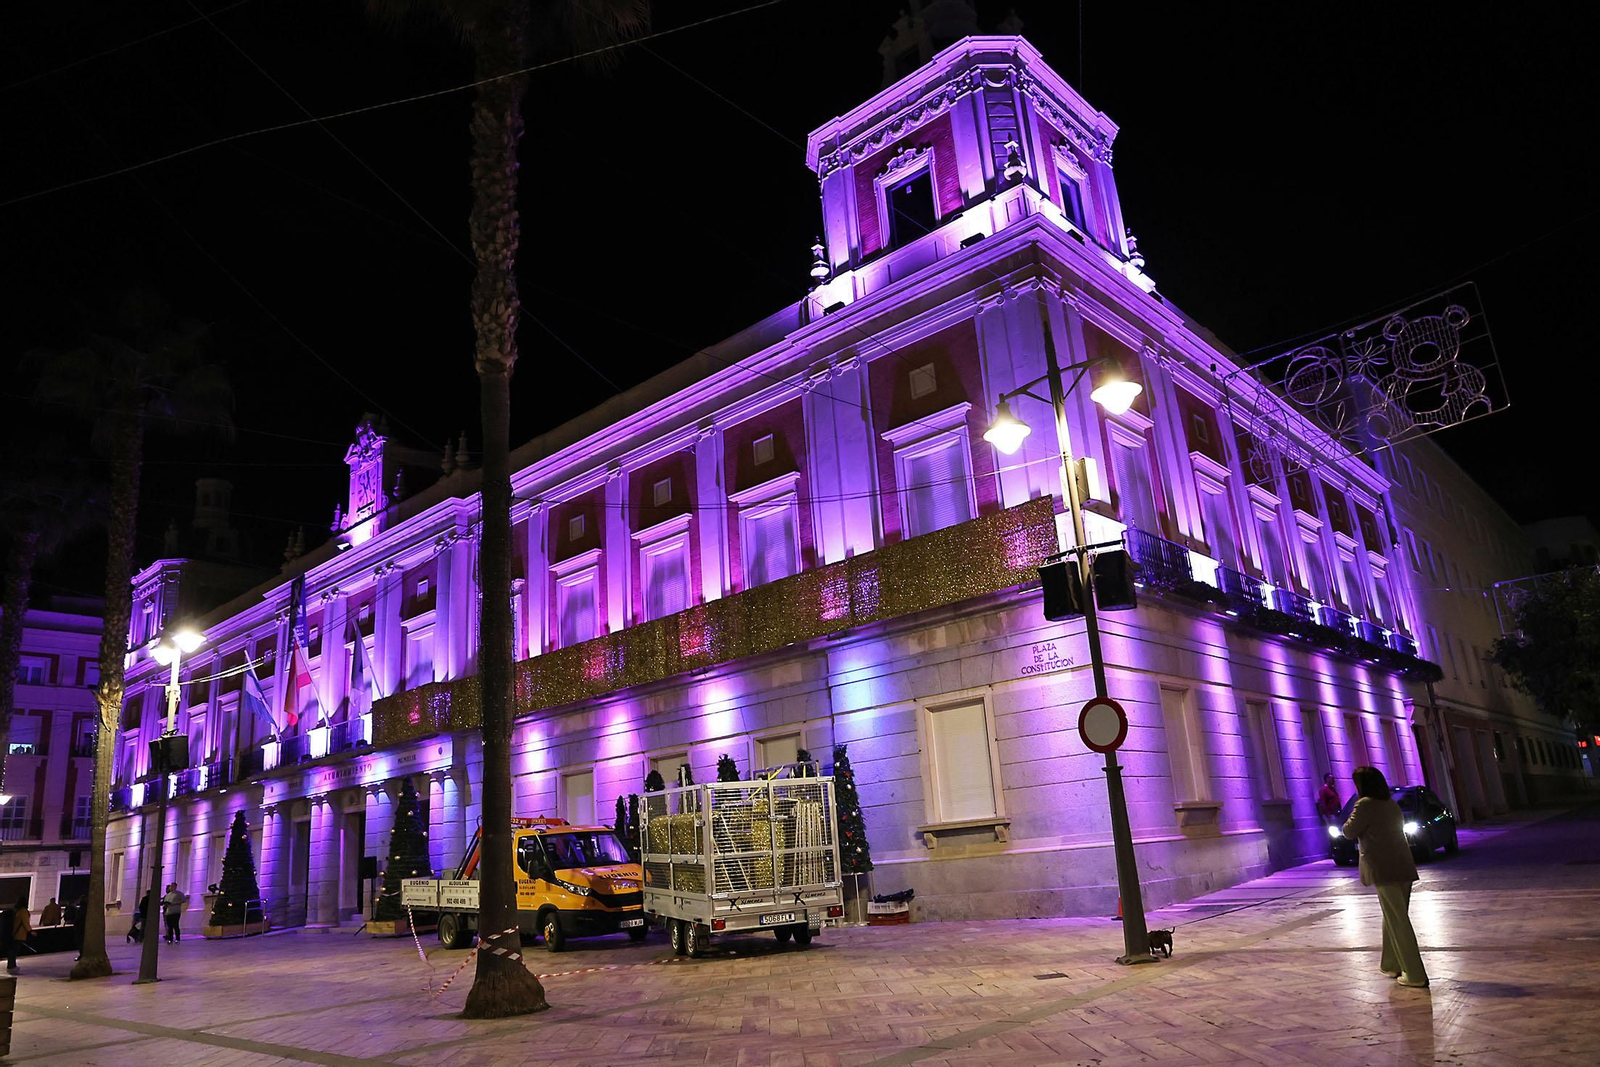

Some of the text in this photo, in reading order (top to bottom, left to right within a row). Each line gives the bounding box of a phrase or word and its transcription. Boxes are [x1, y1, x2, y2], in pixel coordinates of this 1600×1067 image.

[1032, 643, 1057, 654] PLAZA
[1034, 651, 1059, 663] DE LA
[323, 763, 372, 782] AYUNTAMIENTO
[597, 872, 639, 880] EUGENIO
